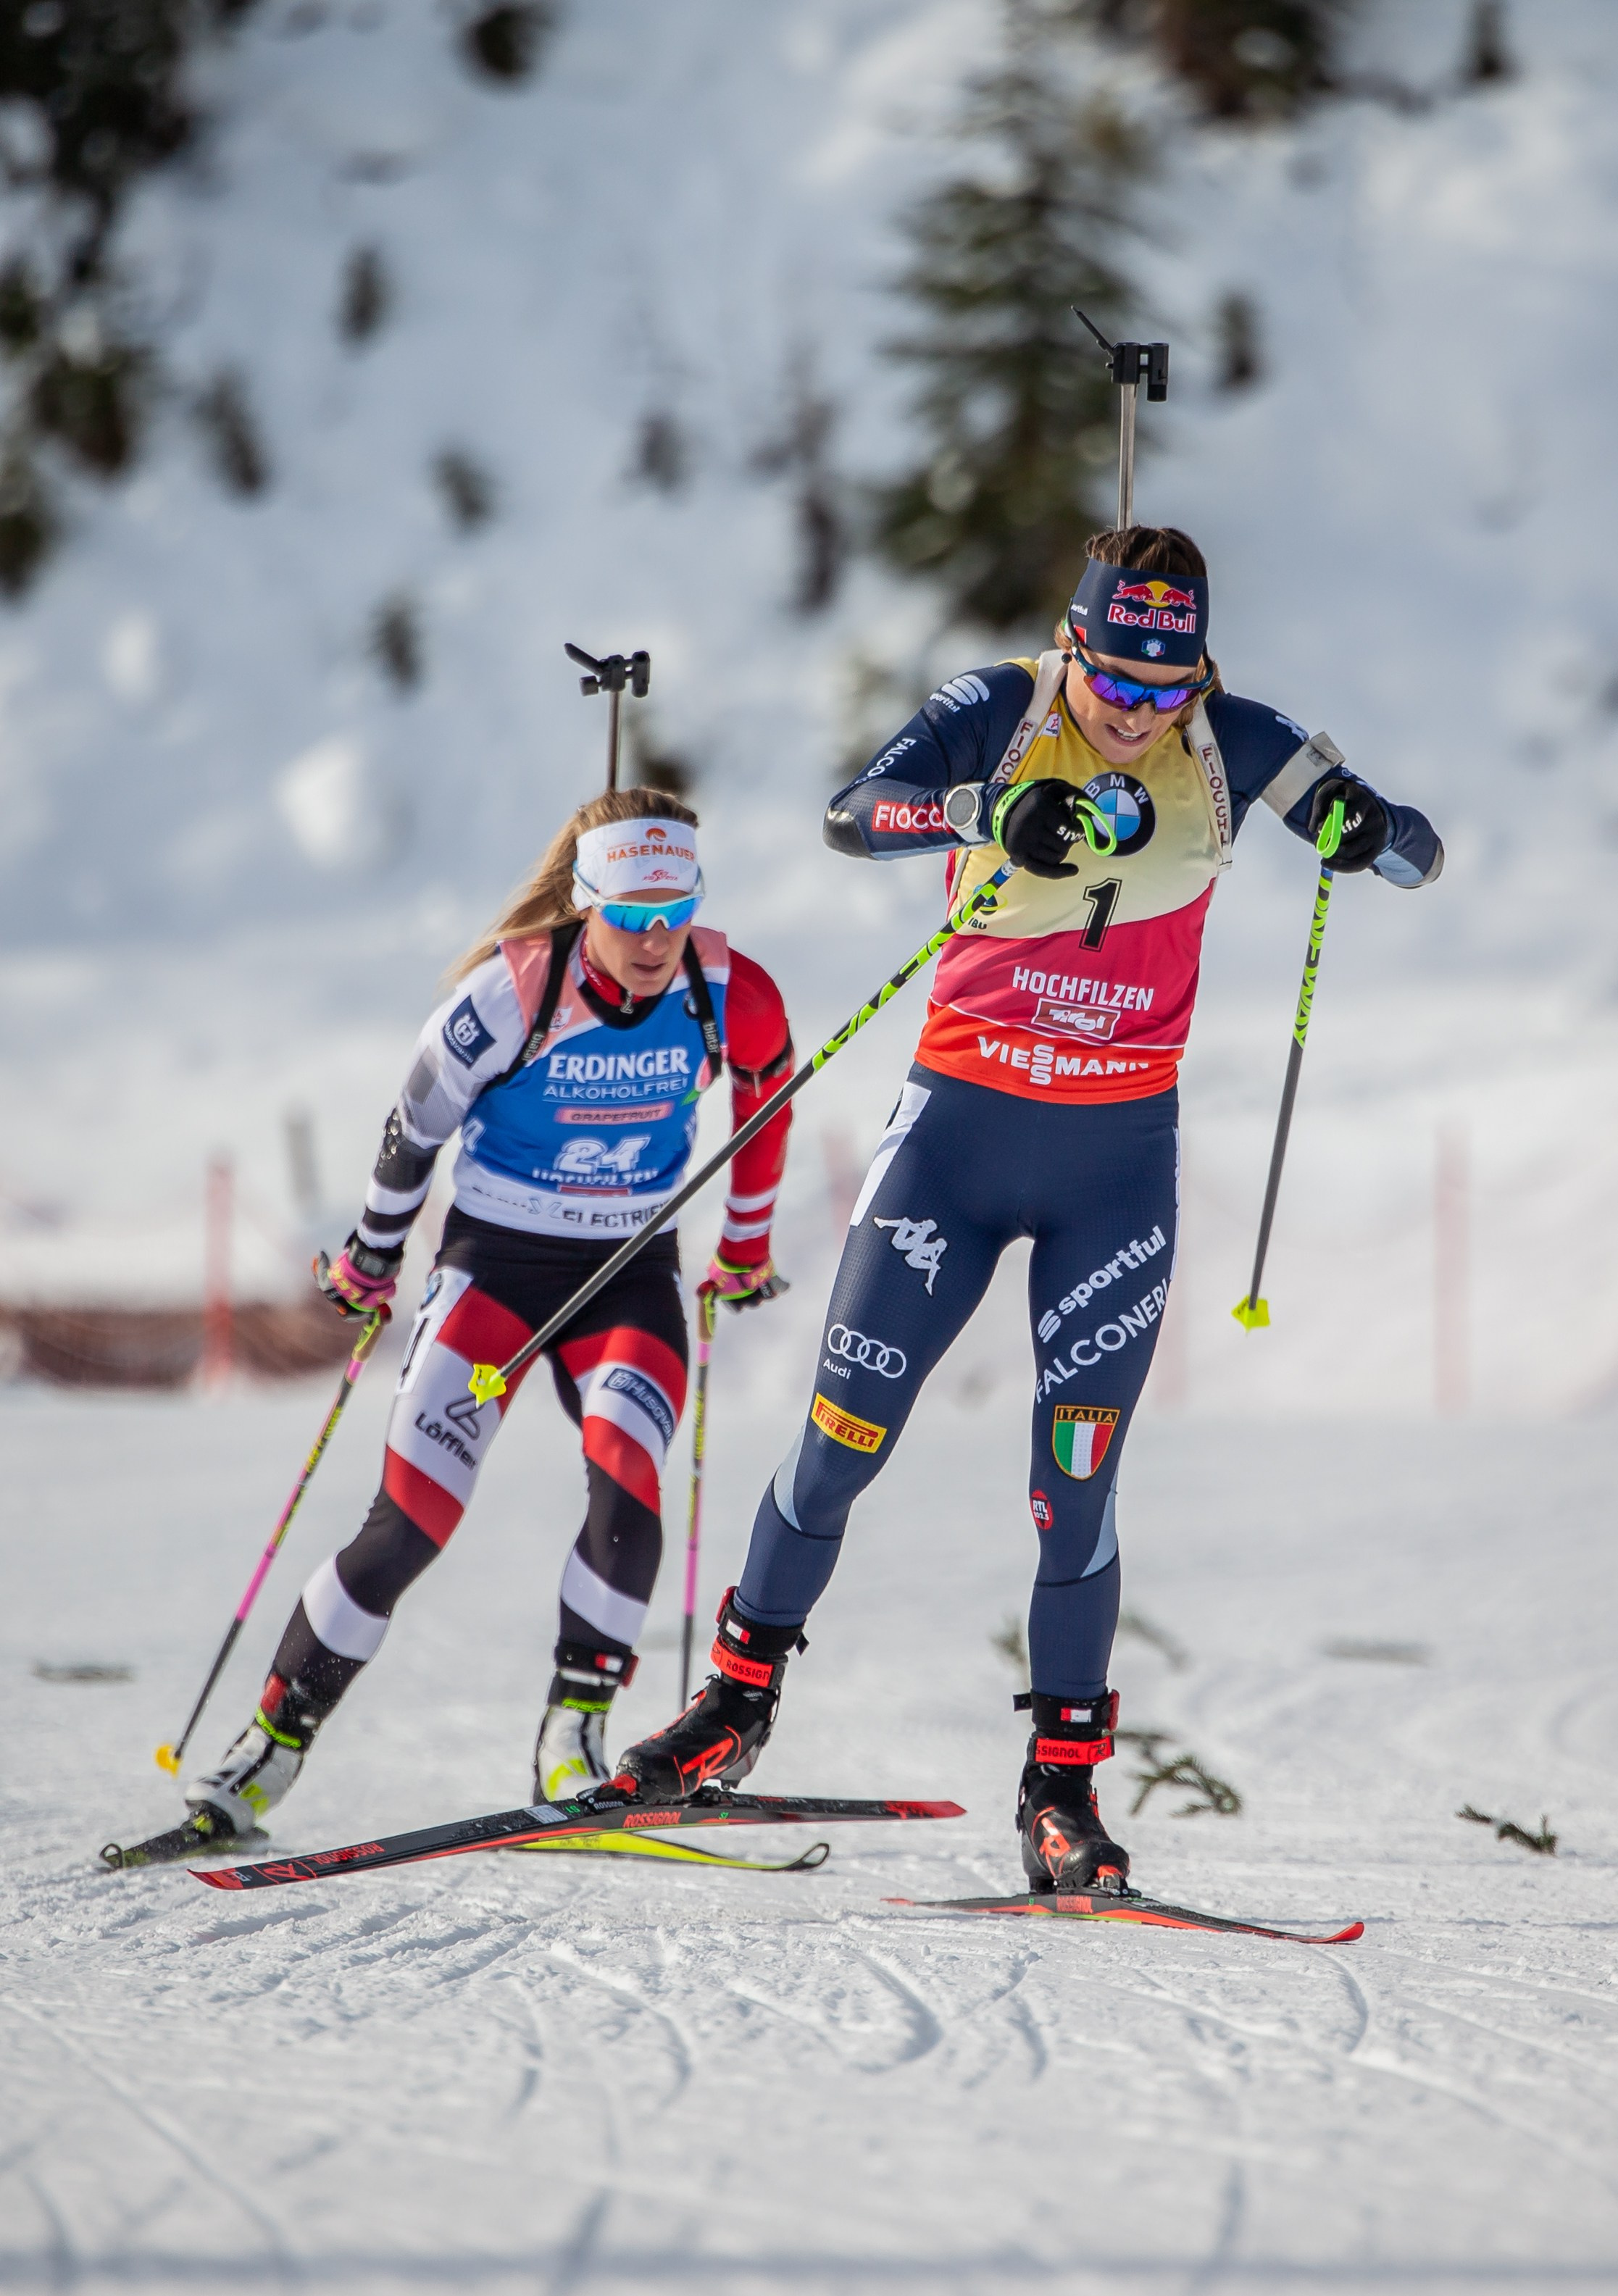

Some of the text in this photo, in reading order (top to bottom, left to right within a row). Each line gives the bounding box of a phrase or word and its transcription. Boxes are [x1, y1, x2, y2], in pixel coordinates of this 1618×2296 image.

[1107, 603, 1197, 634] Red Bull
[930, 693, 961, 714] sportful
[1085, 774, 1149, 805] BMW
[1201, 747, 1230, 846] FIOCCHI
[606, 845, 696, 863] HASENAUER
[967, 917, 988, 930] IBU
[1080, 877, 1123, 953] 1
[1012, 966, 1155, 1012] HOCHFILZEN
[548, 1048, 691, 1084] ERDINGER
[543, 1077, 688, 1100] ALKOHOLFREI
[571, 1109, 662, 1122] GRAPEFRUIT
[551, 1135, 652, 1175] 24
[1059, 1225, 1167, 1315] sportful
[1035, 1277, 1168, 1405] FALCONERI
[823, 1358, 852, 1379] Audi
[815, 1401, 879, 1448] PIRELLI
[1059, 1408, 1114, 1422] ITALIA
[414, 1411, 477, 1471] Löffler
[1033, 1500, 1048, 1513] RTL
[623, 1811, 682, 1828] ROSSIGNOL
